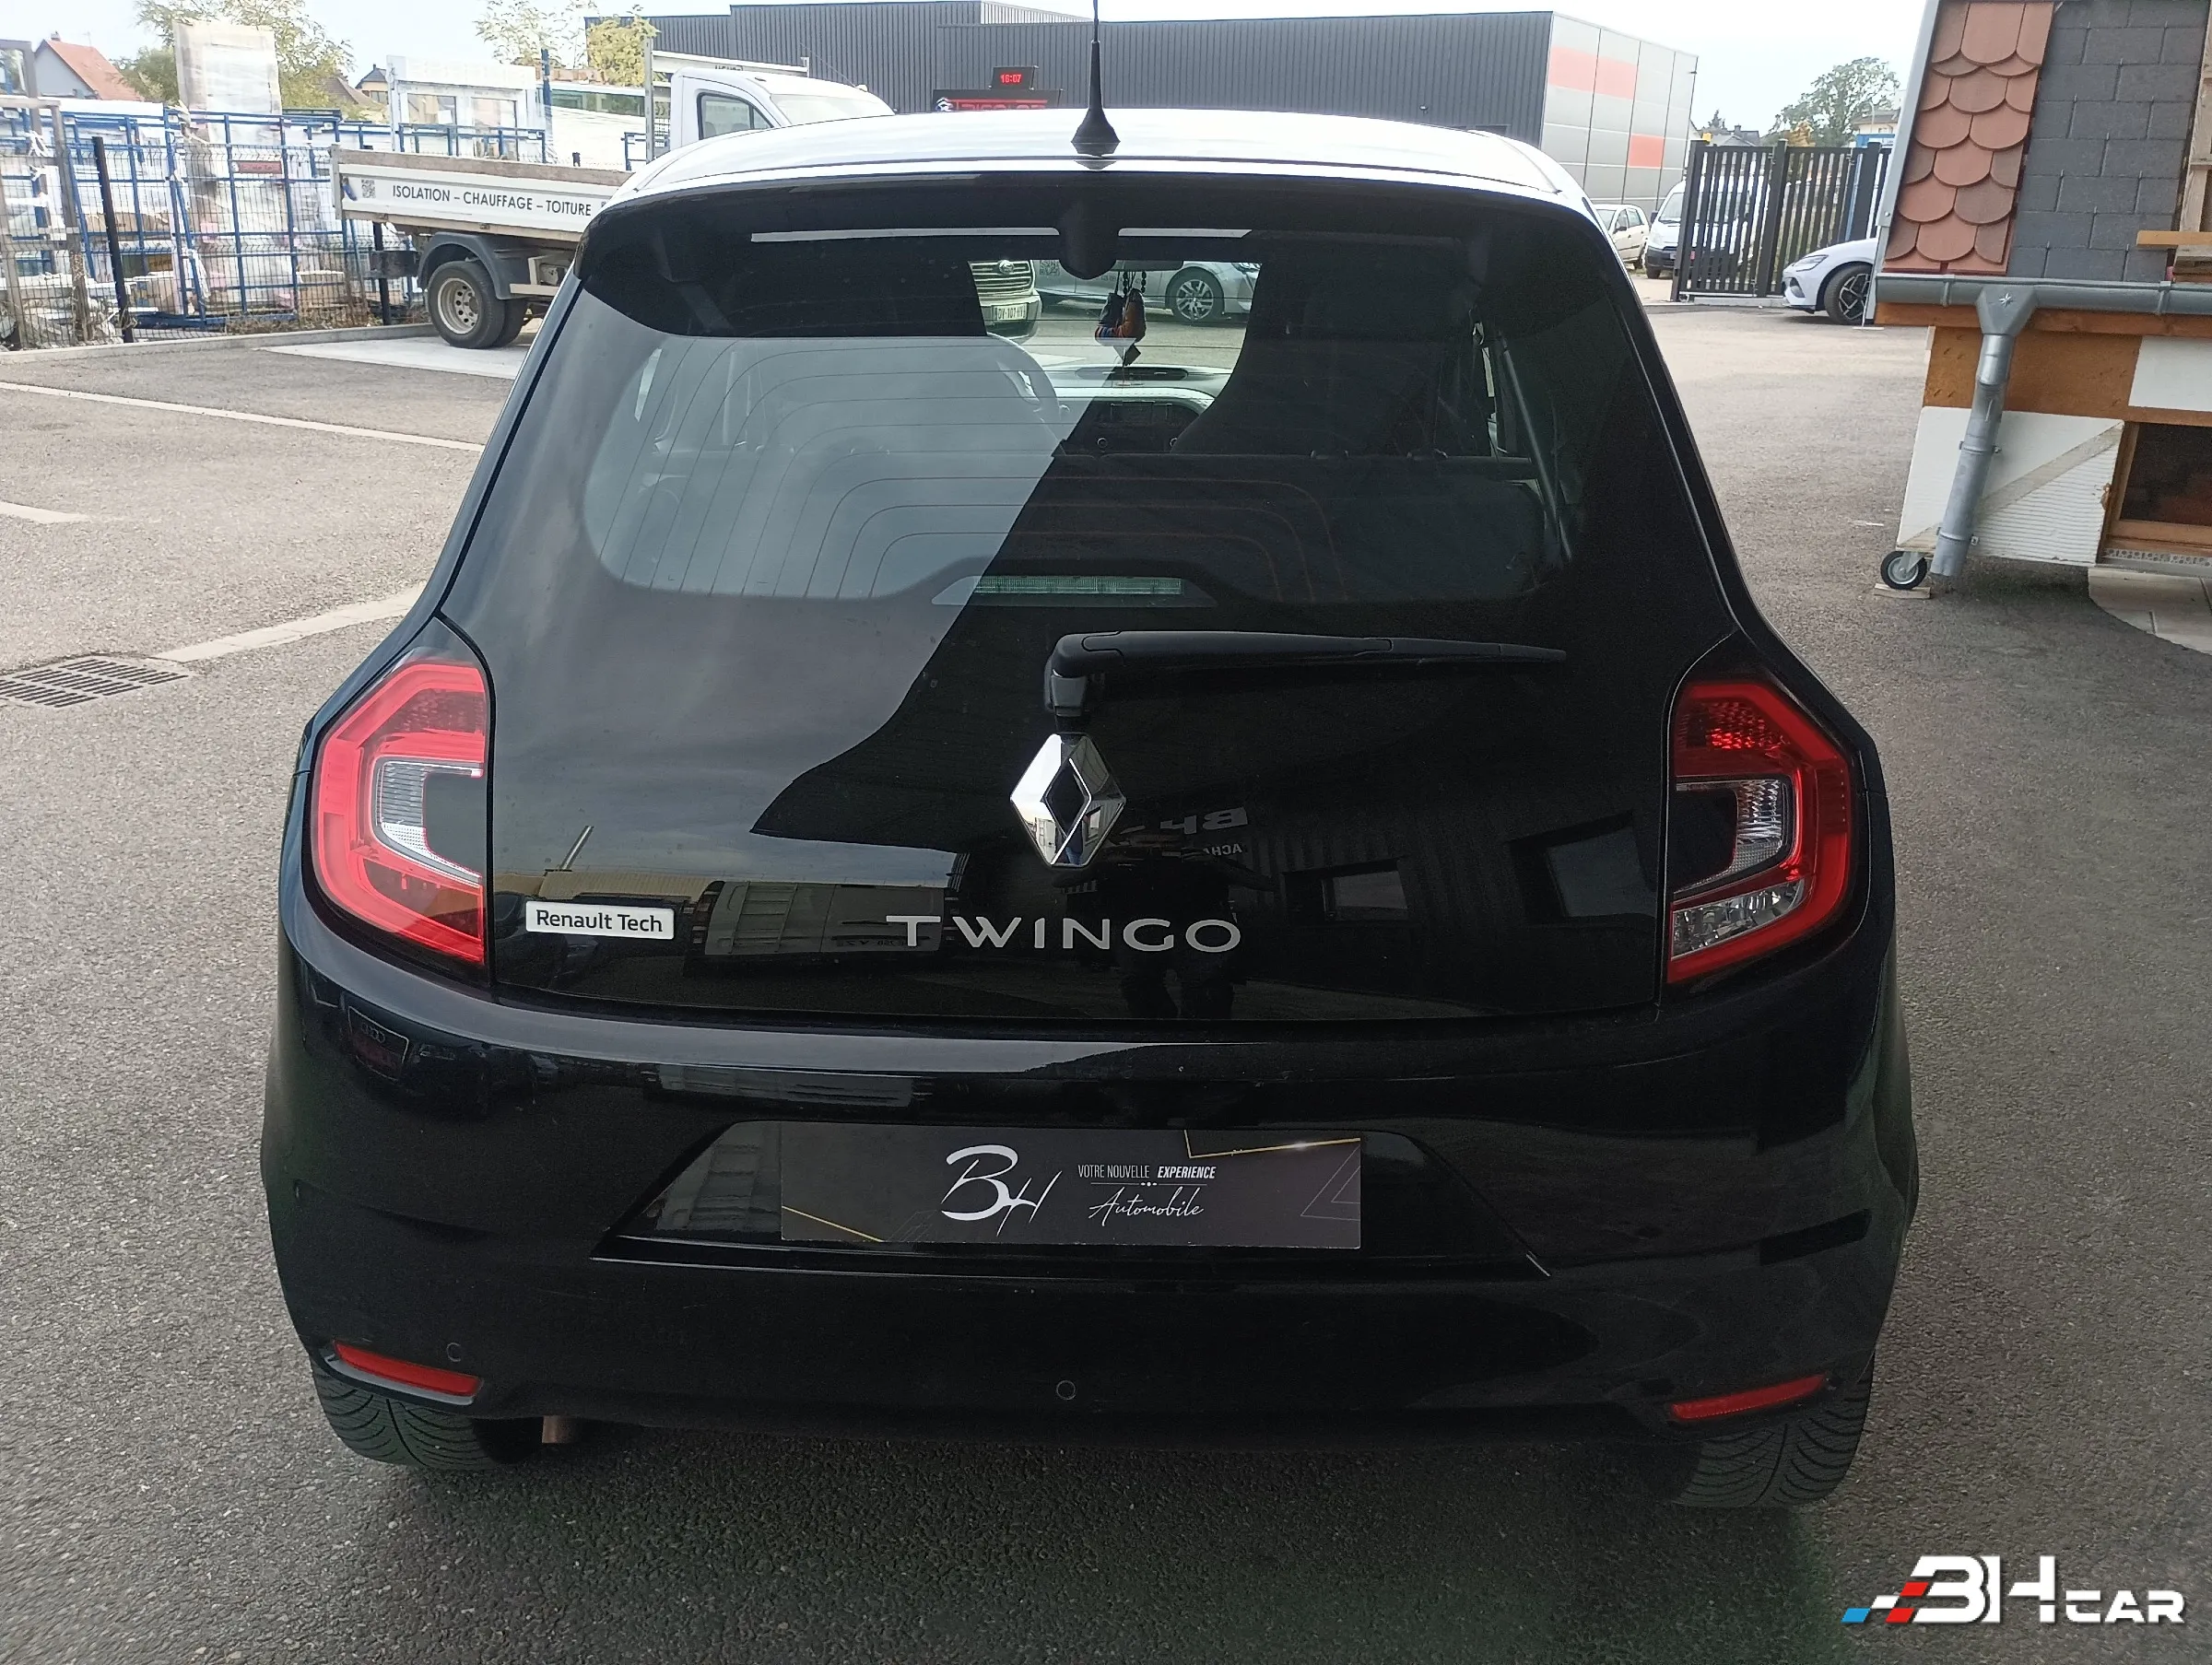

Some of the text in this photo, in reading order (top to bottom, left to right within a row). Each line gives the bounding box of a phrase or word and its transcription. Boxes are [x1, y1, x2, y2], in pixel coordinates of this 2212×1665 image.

[1000, 74, 1021, 83] 16:07
[393, 185, 450, 202] ISOLATION
[464, 192, 533, 210] CHAUFFAGE
[547, 200, 592, 217] TOITURE
[536, 909, 663, 932] Renault Tech
[887, 916, 1241, 953] TWINGO
[1077, 1164, 1216, 1179] VOTRE NOUVELLE EXPERIENCE
[941, 1144, 1062, 1237] BH
[1088, 1186, 1204, 1226] Automobile
